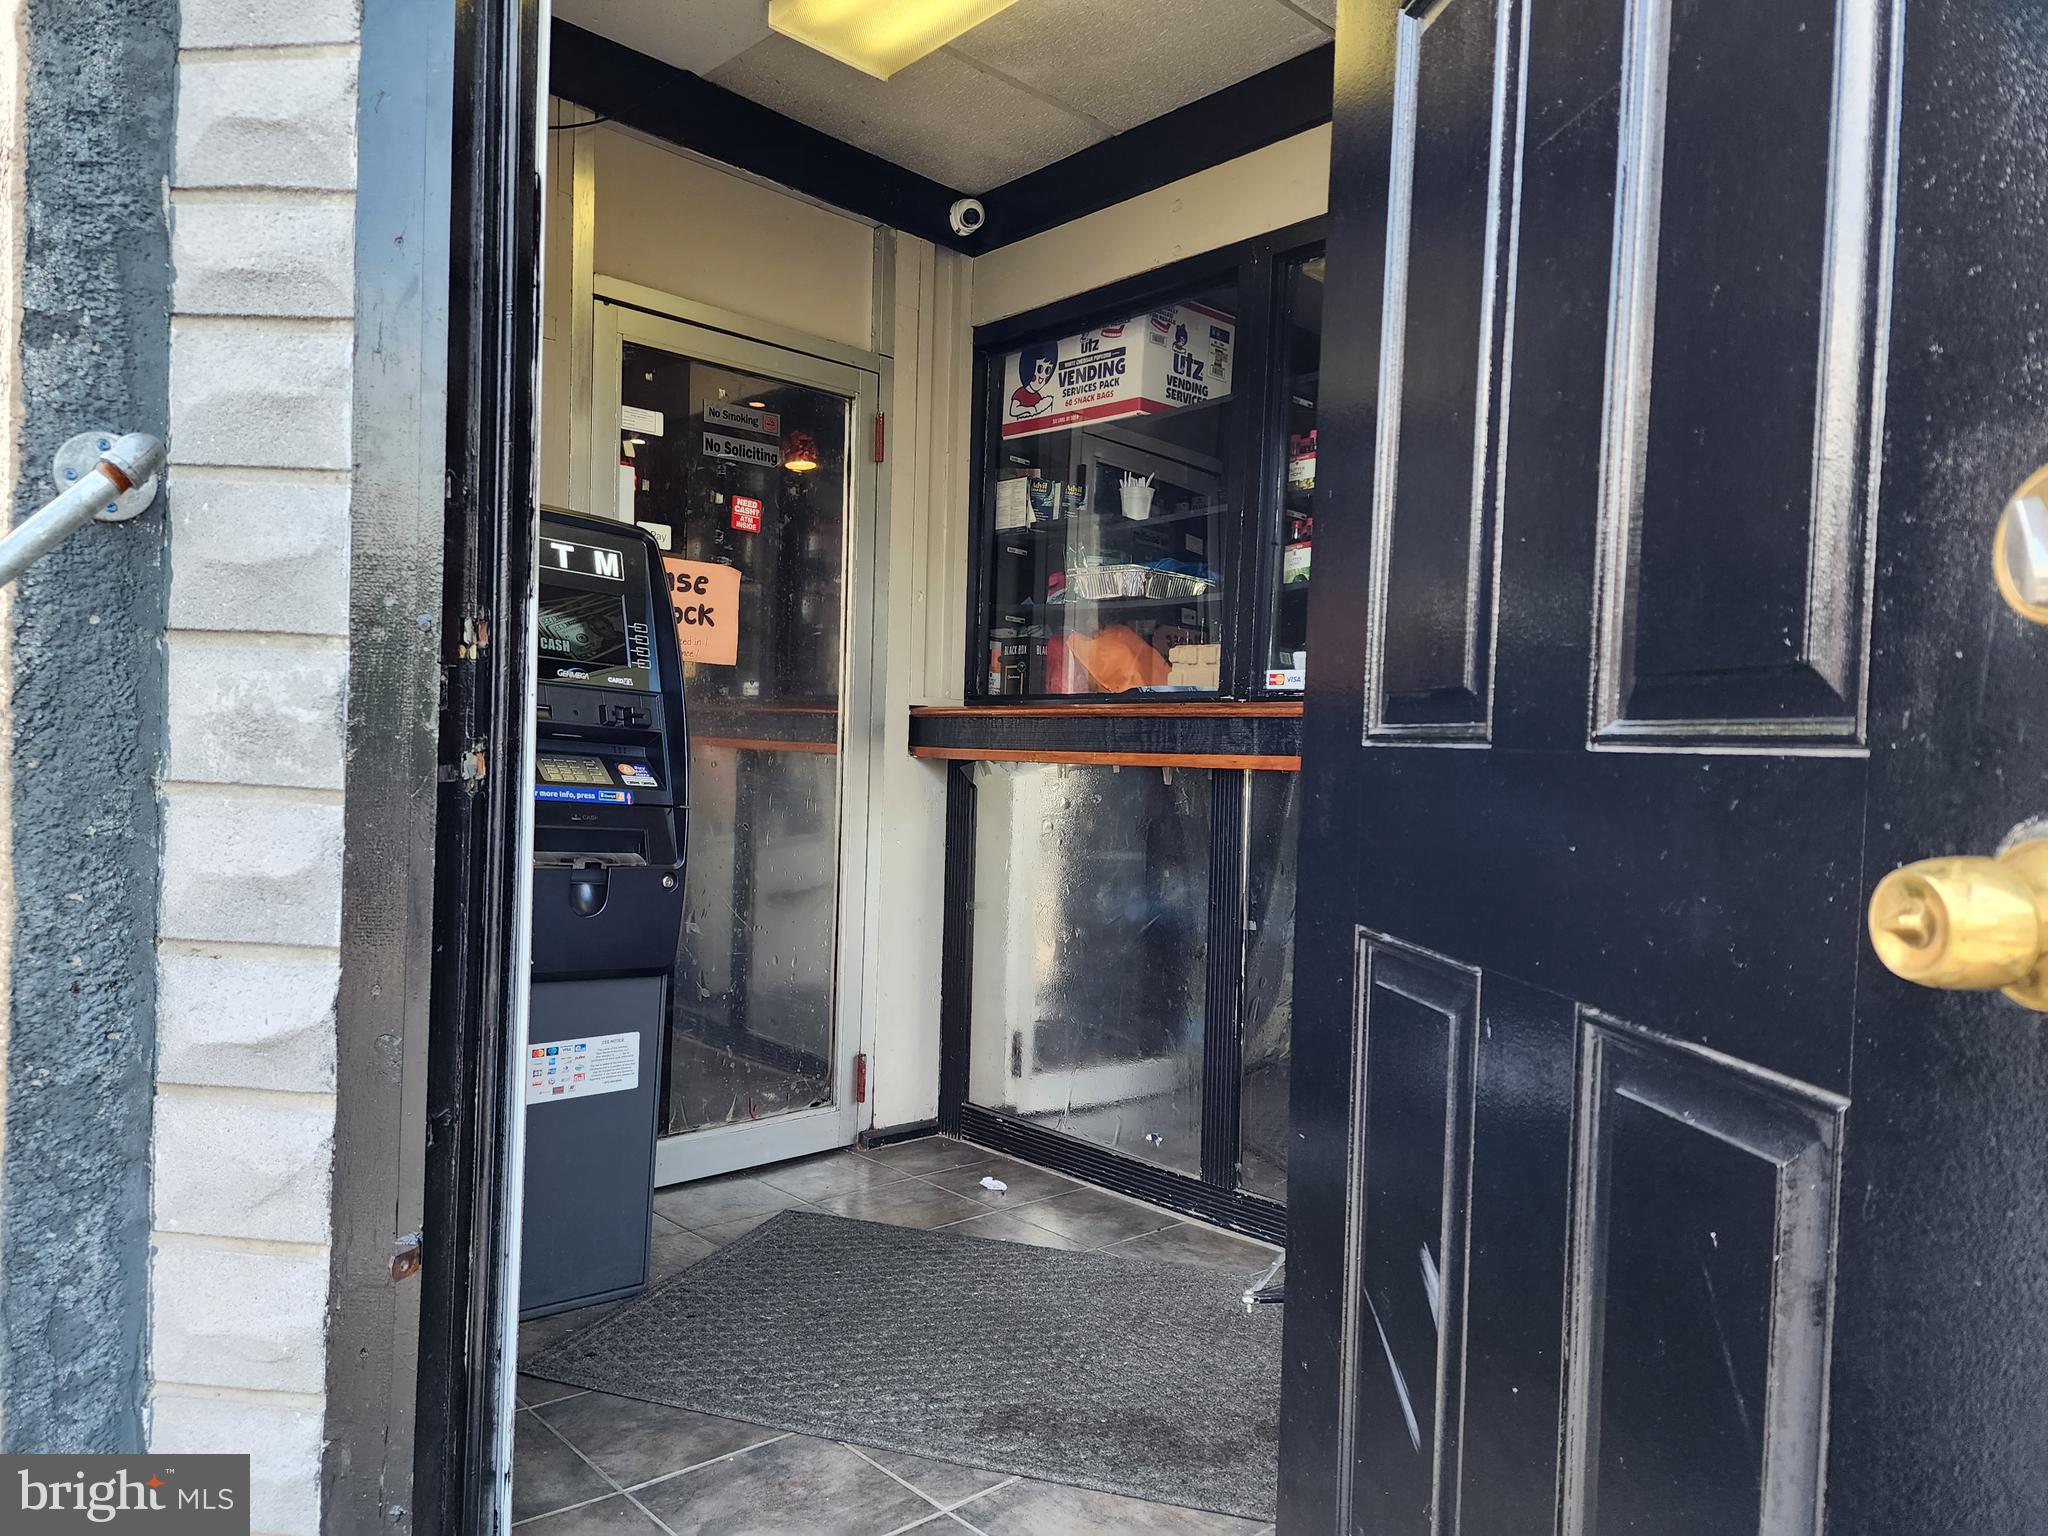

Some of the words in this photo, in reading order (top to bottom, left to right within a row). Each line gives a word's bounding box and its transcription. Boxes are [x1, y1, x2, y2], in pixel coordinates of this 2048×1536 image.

[1058, 358, 1126, 388] VENDING
[1062, 382, 1097, 398] SERVICES
[1100, 377, 1120, 390] PACK
[1166, 374, 1209, 397] VENDING
[1074, 394, 1095, 406] SNACK
[1097, 390, 1114, 398] BAGS
[708, 406, 721, 418] No
[722, 409, 759, 428] Smoking
[705, 437, 721, 453] No
[724, 441, 778, 467] Soliciting
[734, 505, 760, 517] CASH?
[736, 498, 758, 509] NEED
[735, 521, 757, 531] INSIDE
[740, 516, 754, 524] ATM
[550, 542, 620, 578] TM
[673, 603, 715, 627] ock
[540, 637, 571, 653] CASH
[1004, 645, 1018, 656] BLACK
[1018, 645, 1028, 655] BOX
[560, 790, 576, 799] info,
[576, 792, 596, 800] press
